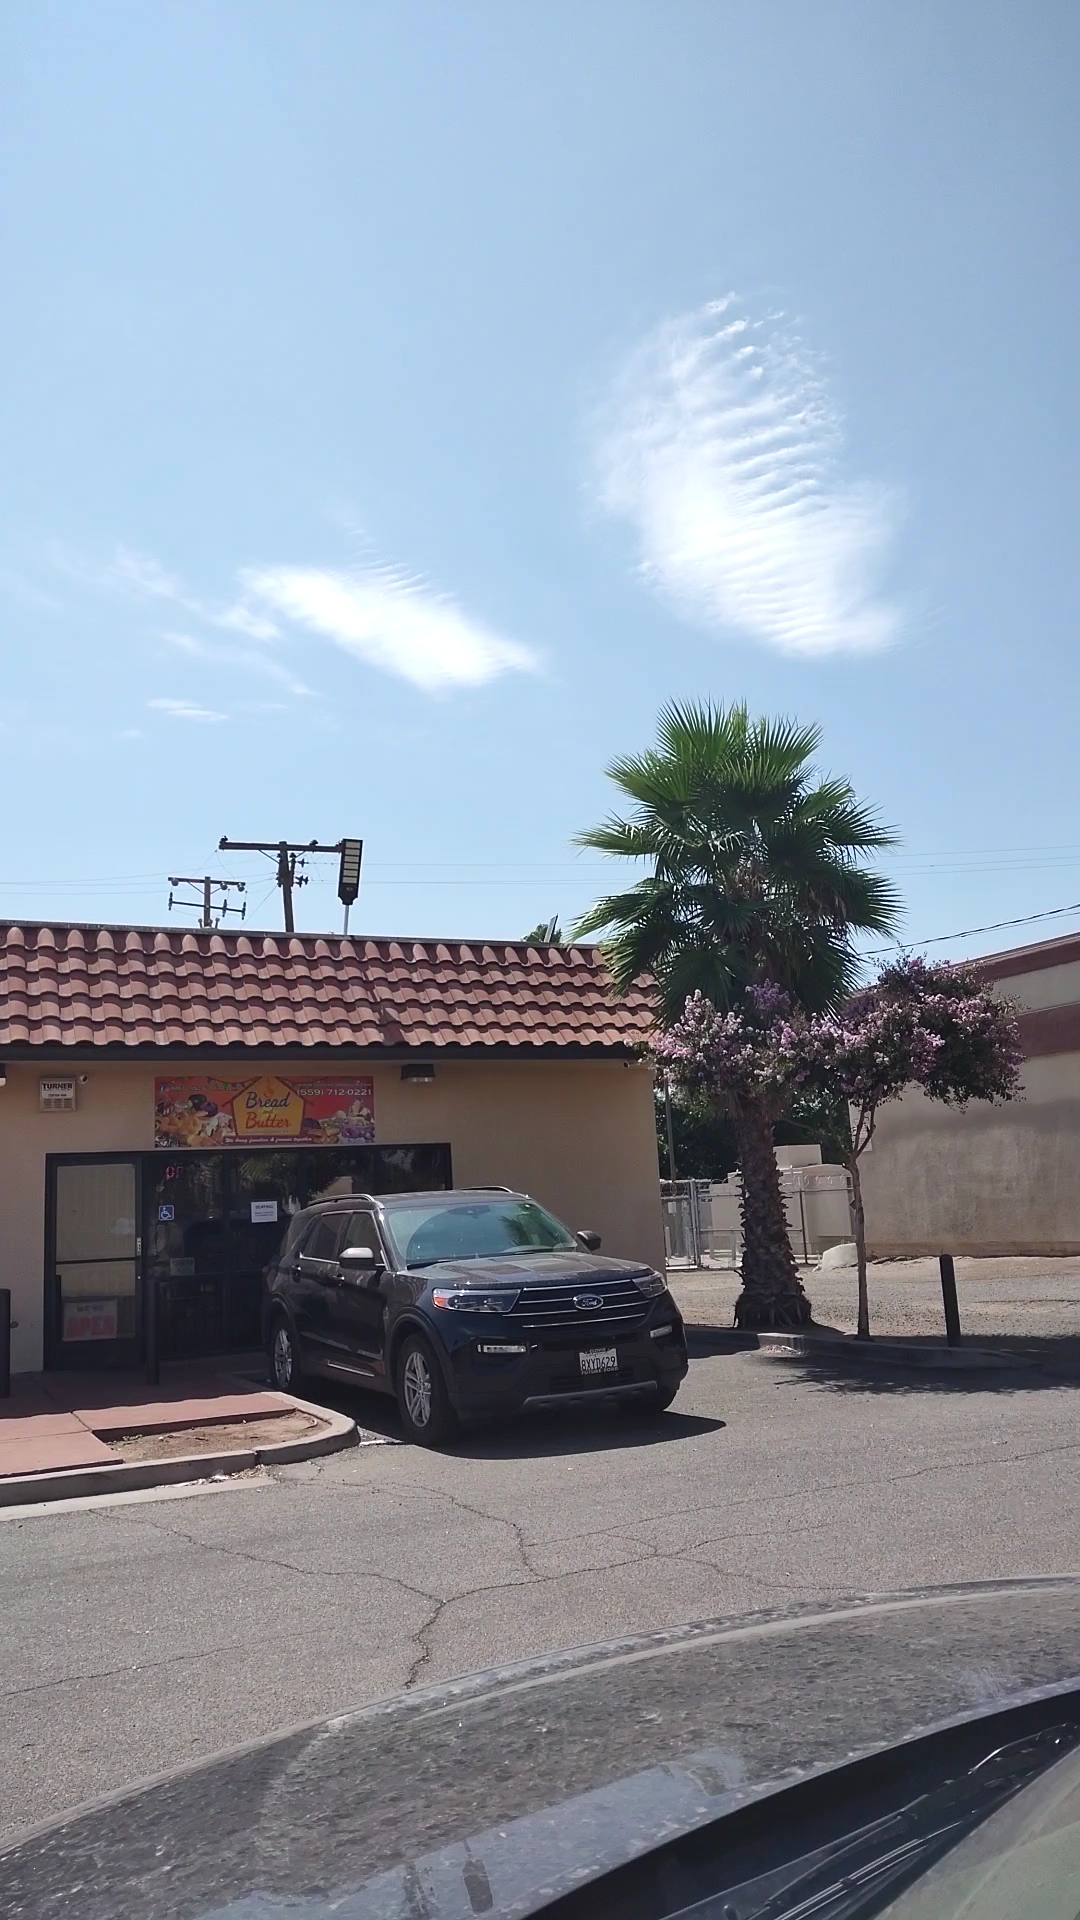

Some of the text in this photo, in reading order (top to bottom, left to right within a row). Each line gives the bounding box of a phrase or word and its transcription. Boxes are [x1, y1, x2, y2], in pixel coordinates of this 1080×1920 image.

[246, 1091, 290, 1109] Bread
[297, 1088, 372, 1097] (559) 712-0221
[245, 1112, 292, 1129] Butter
[582, 1298, 598, 1306] Ford
[581, 1356, 616, 1371] 8XYD629
